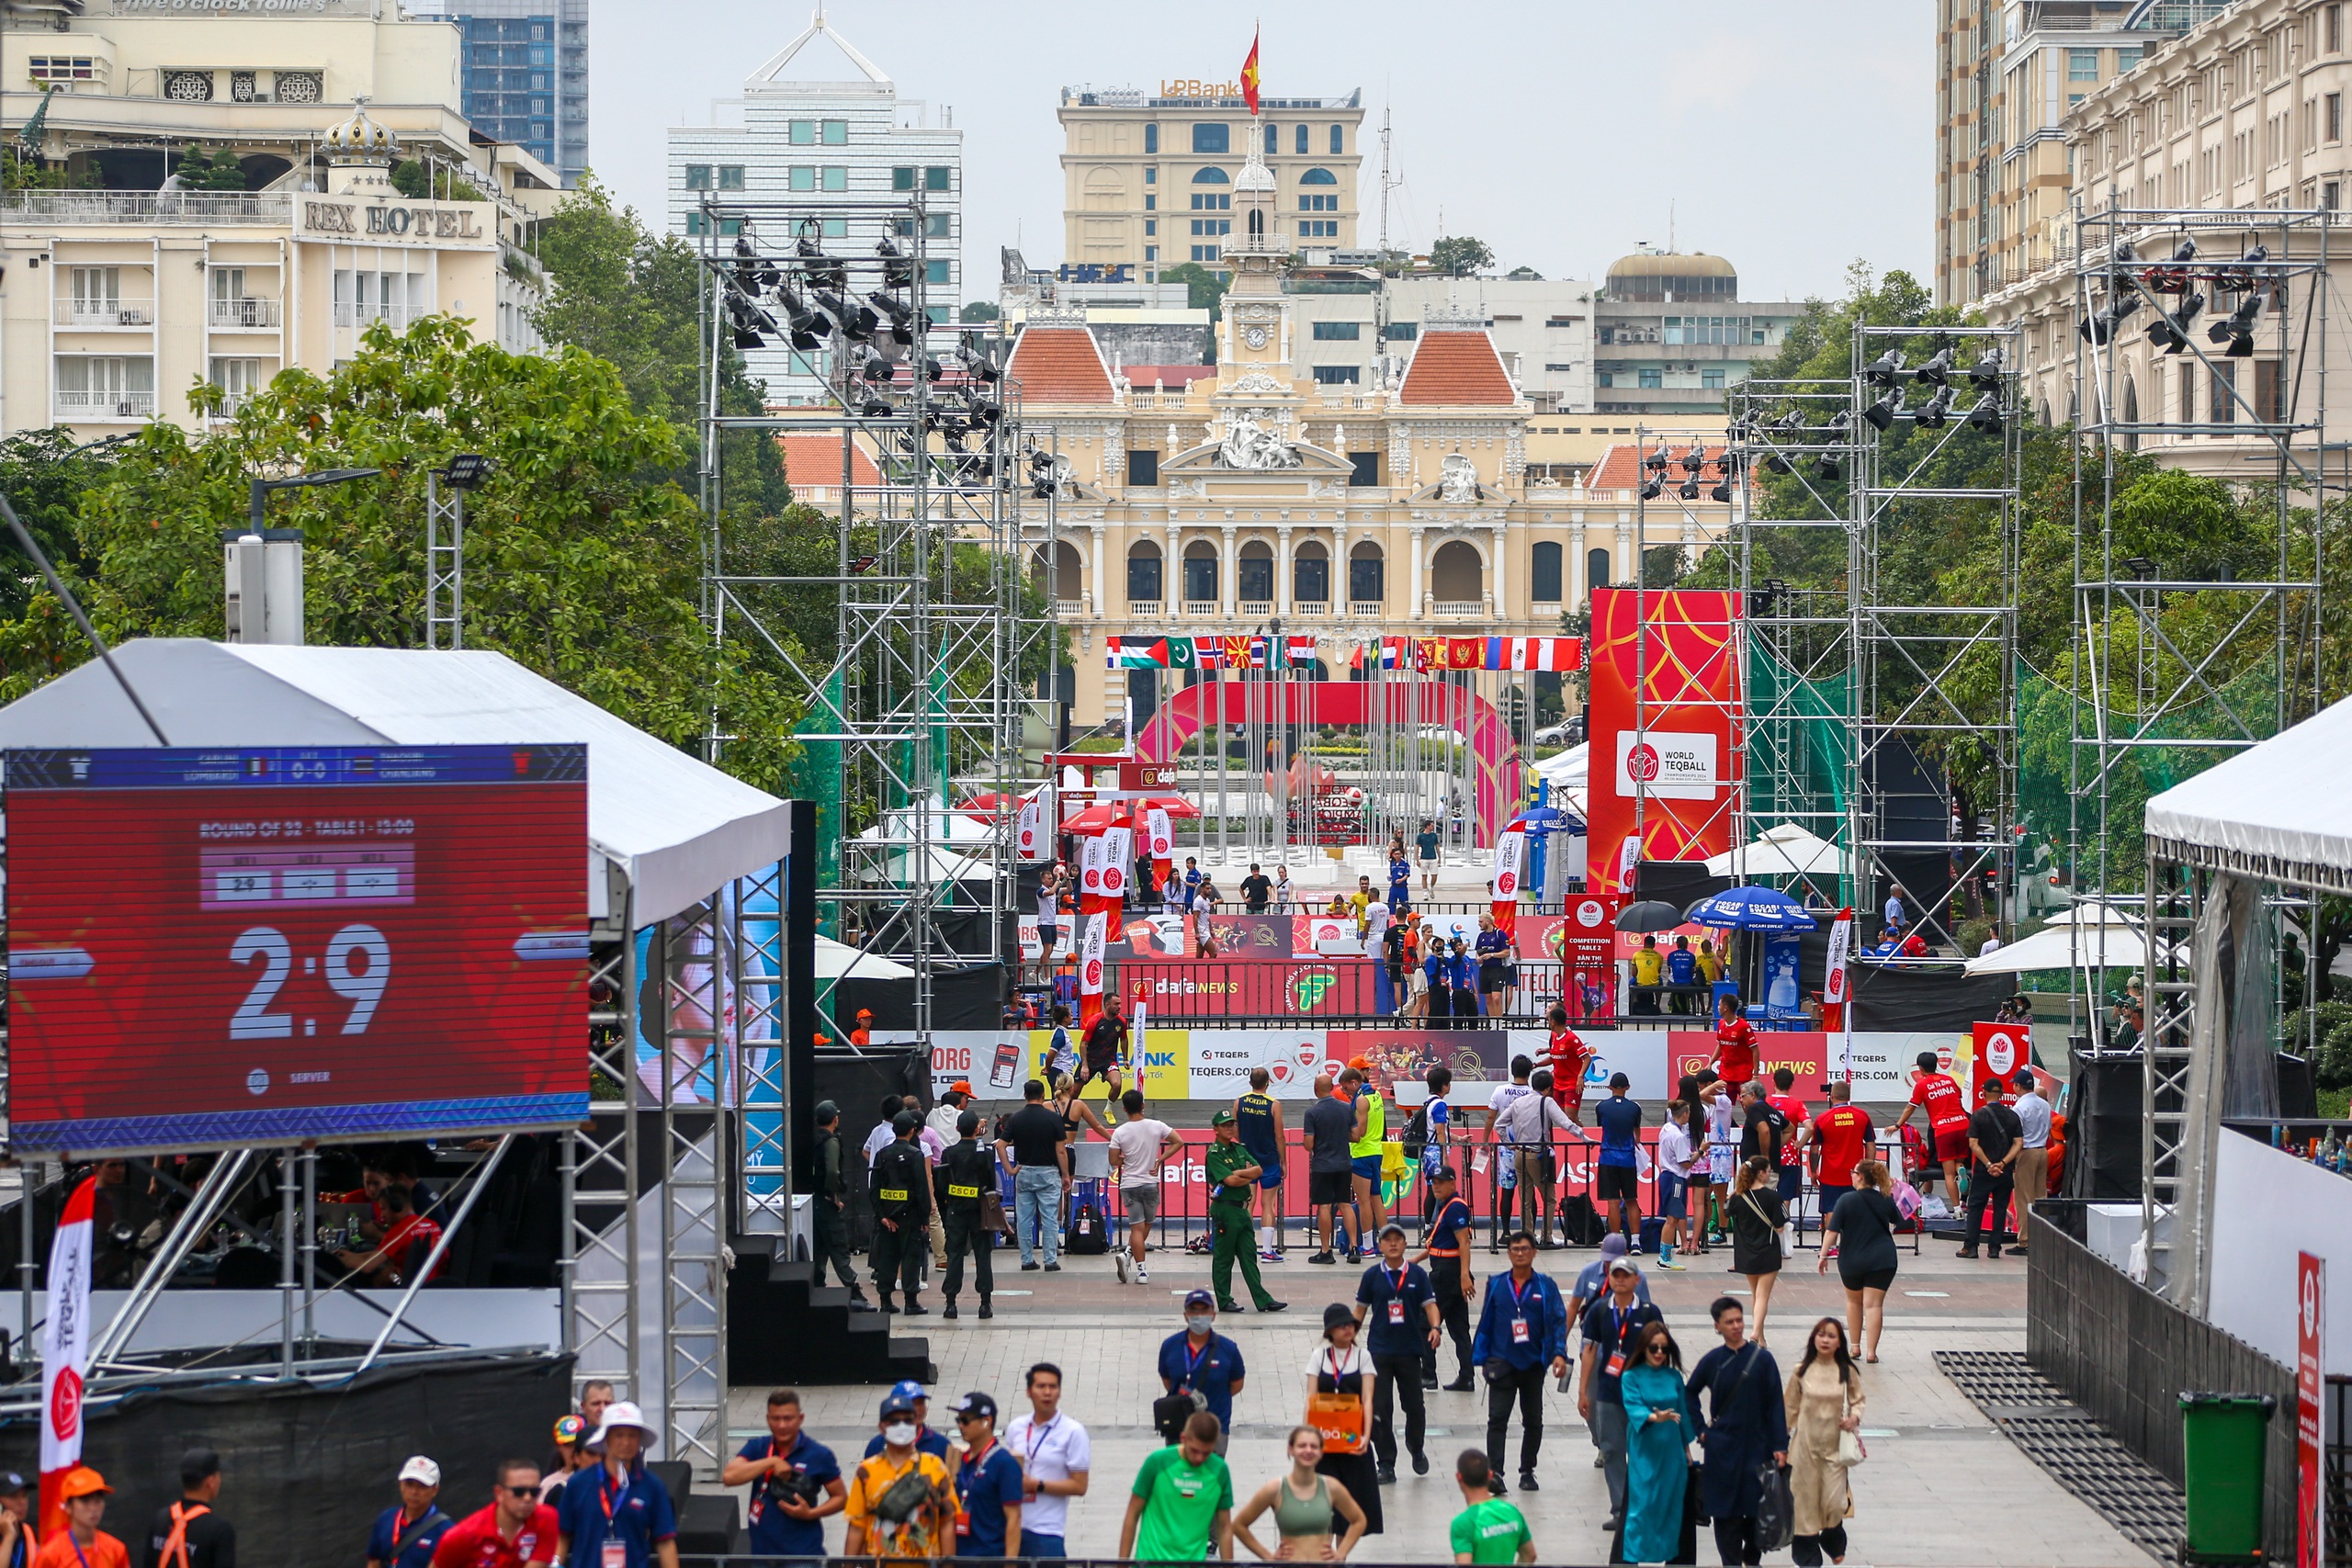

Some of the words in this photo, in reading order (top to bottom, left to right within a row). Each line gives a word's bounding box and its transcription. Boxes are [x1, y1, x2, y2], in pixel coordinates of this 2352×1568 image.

[1161, 80, 1239, 98] LPBank
[305, 201, 356, 232] REX
[367, 207, 482, 239] HOTEL
[1665, 751, 1695, 761] WORLD
[1664, 761, 1707, 772] TEQBALL
[199, 822, 255, 839] ROUND
[259, 821, 280, 837] OF
[284, 820, 302, 837] 32
[314, 820, 357, 836] TABLE
[377, 818, 414, 834] 13:00
[1156, 977, 1238, 997] dafaNEWS
[933, 1047, 971, 1071] ORG
[1852, 1055, 1887, 1063] TEQERS
[289, 1071, 331, 1084] SERVER
[1928, 1086, 1956, 1100] CHINA
[1834, 1111, 1854, 1120] ESPAÑA
